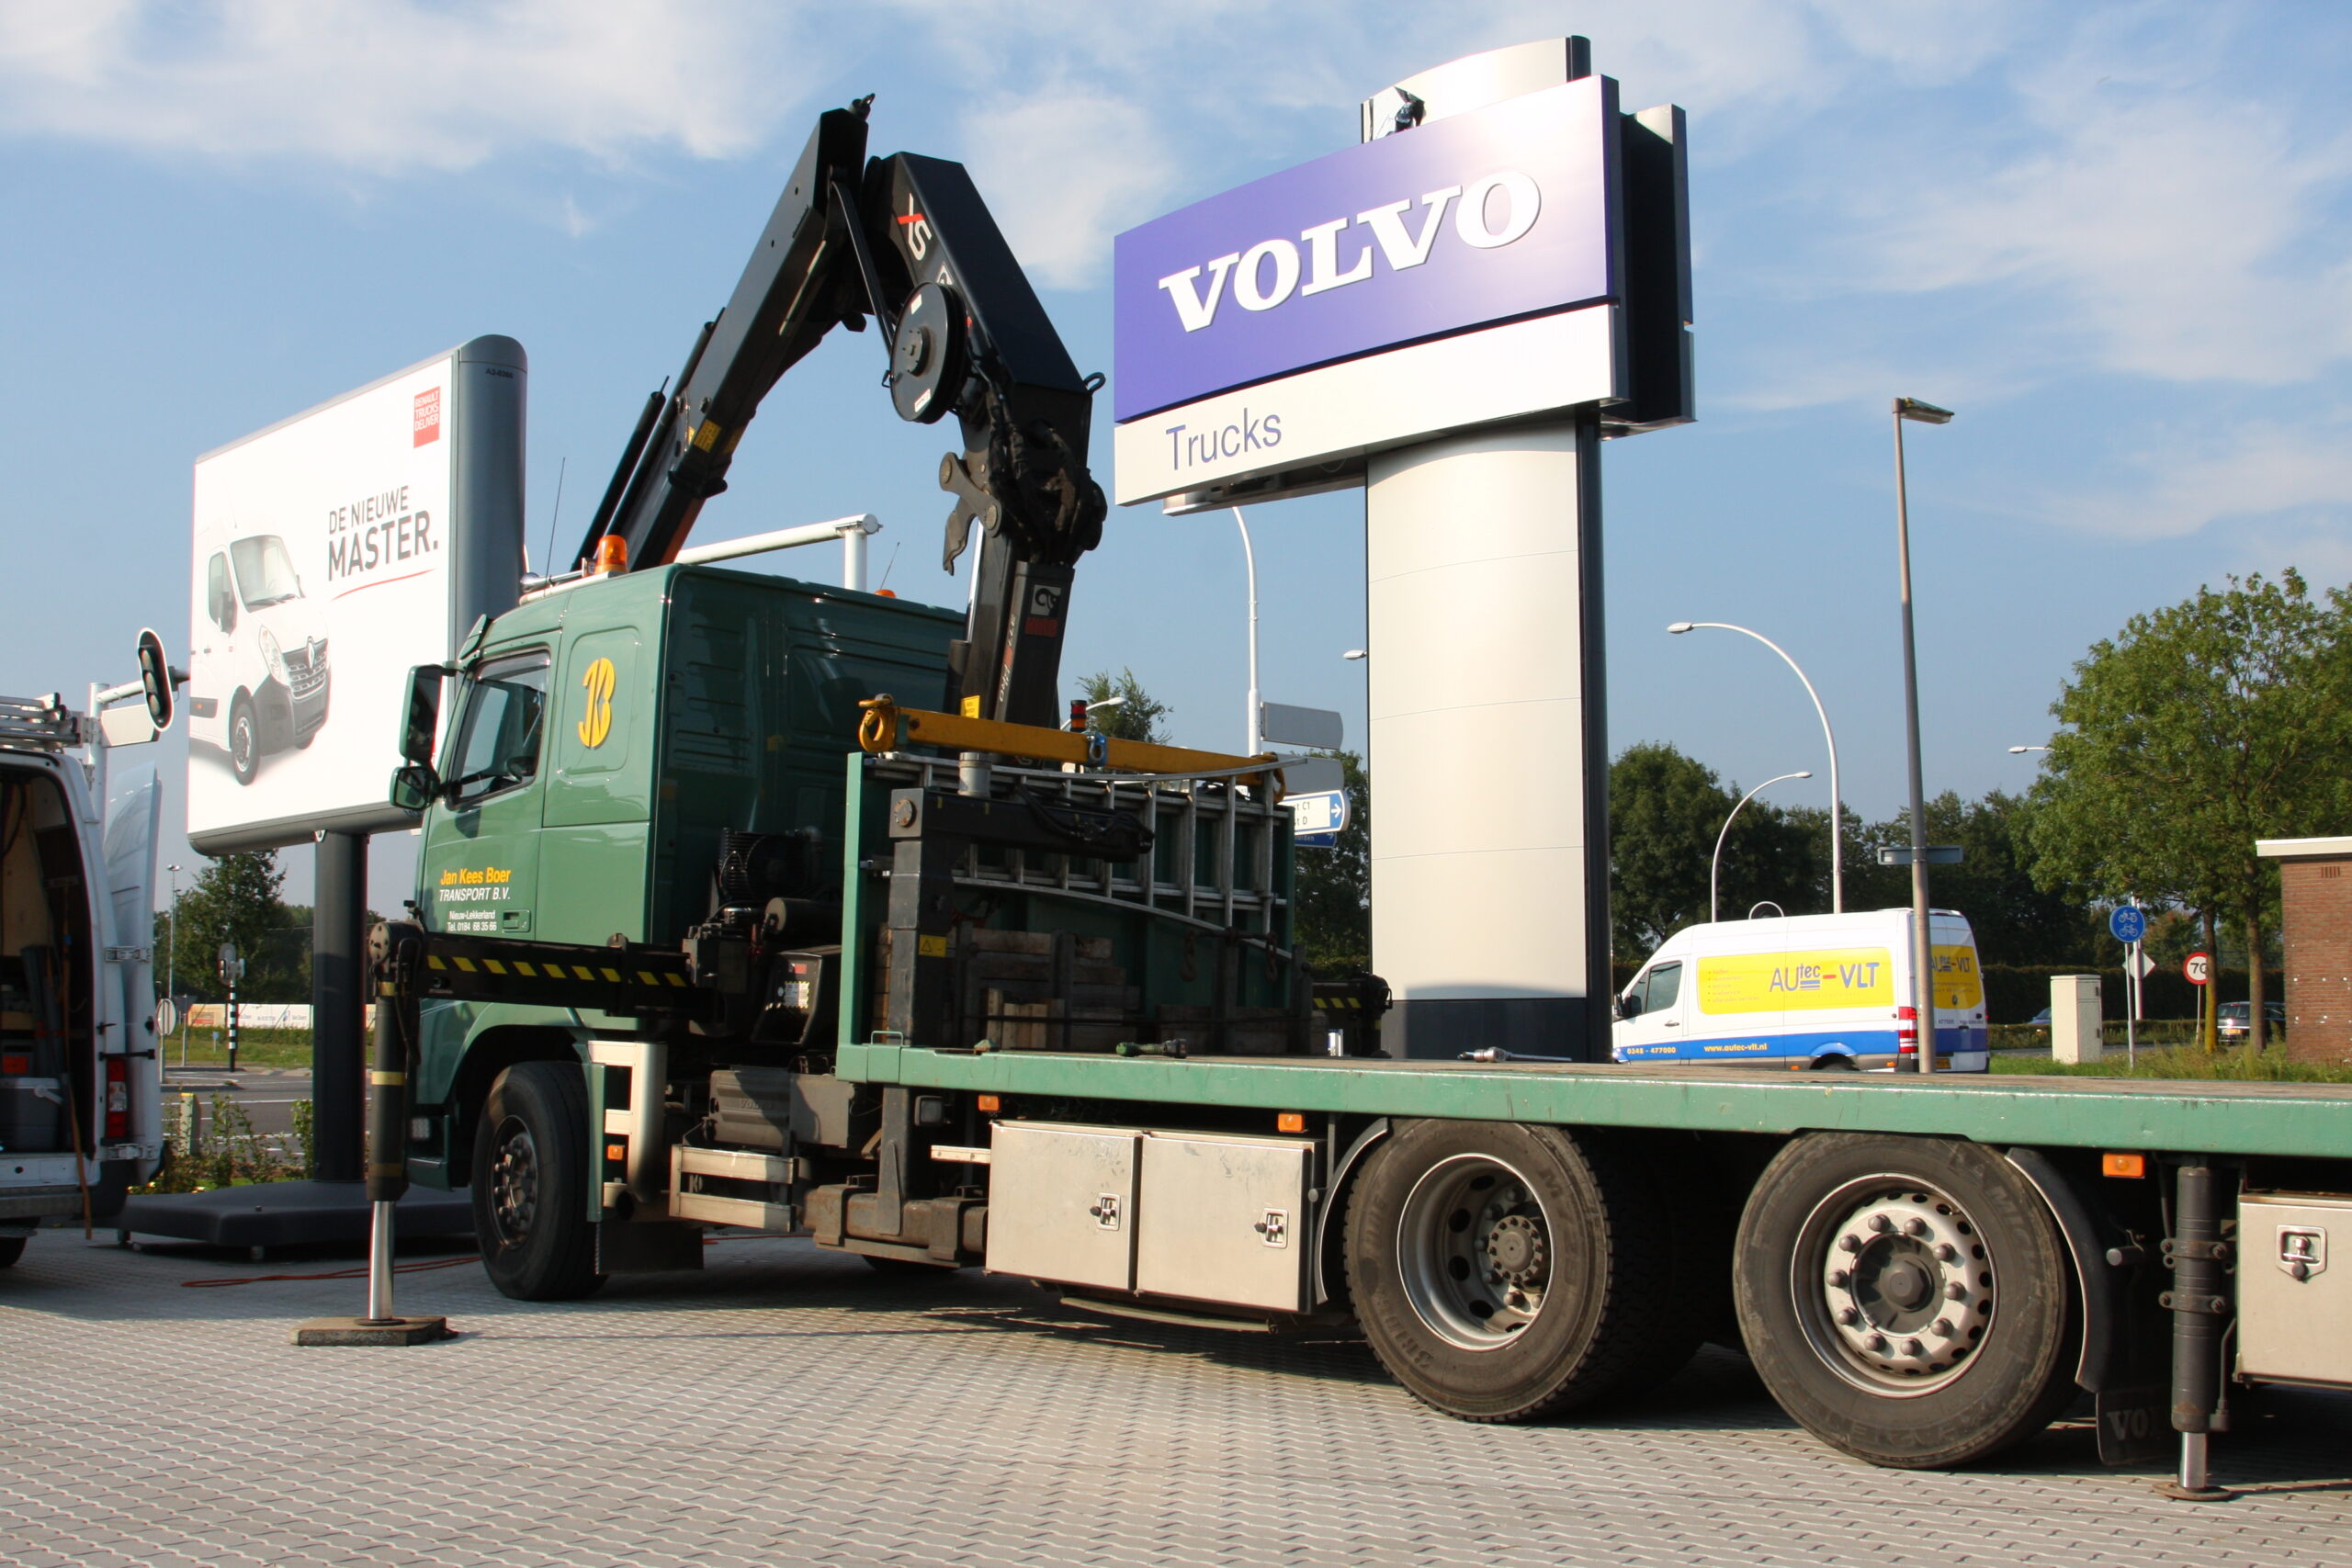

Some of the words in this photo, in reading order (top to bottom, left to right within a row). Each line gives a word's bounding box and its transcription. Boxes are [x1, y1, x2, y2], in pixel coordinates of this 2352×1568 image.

[1159, 171, 1542, 333] VOLVO
[414, 402, 439, 420] TRUCKS
[414, 413, 439, 431] DELIVER
[1165, 407, 1283, 470] Trucks
[329, 507, 346, 535] DE
[351, 485, 409, 527] NIEUWE
[329, 510, 438, 581] MASTER.
[1302, 816, 1308, 825] D
[439, 869, 458, 885] Jan
[459, 868, 483, 884] Kees
[486, 866, 512, 883] Boer
[439, 887, 492, 902] TRANSPORT
[492, 886, 511, 900] B.V.
[447, 922, 456, 931] Tel.
[457, 921, 471, 931] 0184
[2189, 962, 2207, 975] 70
[1704, 1043, 1767, 1052] www.autec-vlt.nl
